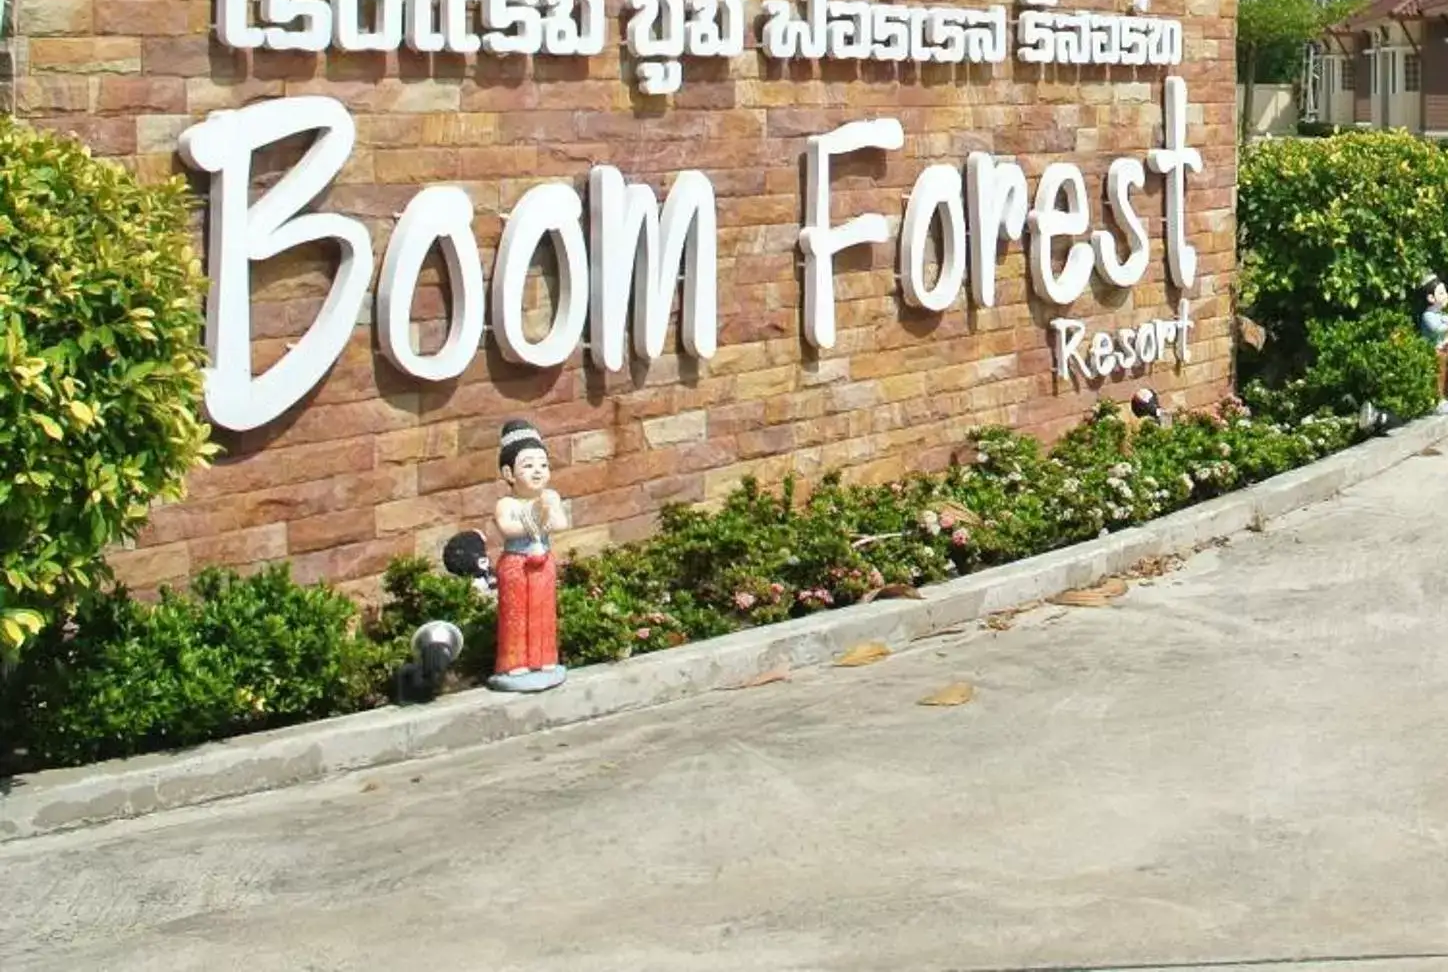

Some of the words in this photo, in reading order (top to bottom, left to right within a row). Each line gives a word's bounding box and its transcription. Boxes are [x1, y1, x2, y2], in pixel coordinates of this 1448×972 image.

[179, 95, 717, 431] Boom
[800, 76, 1202, 349] Forest
[1050, 298, 1195, 381] Resort
